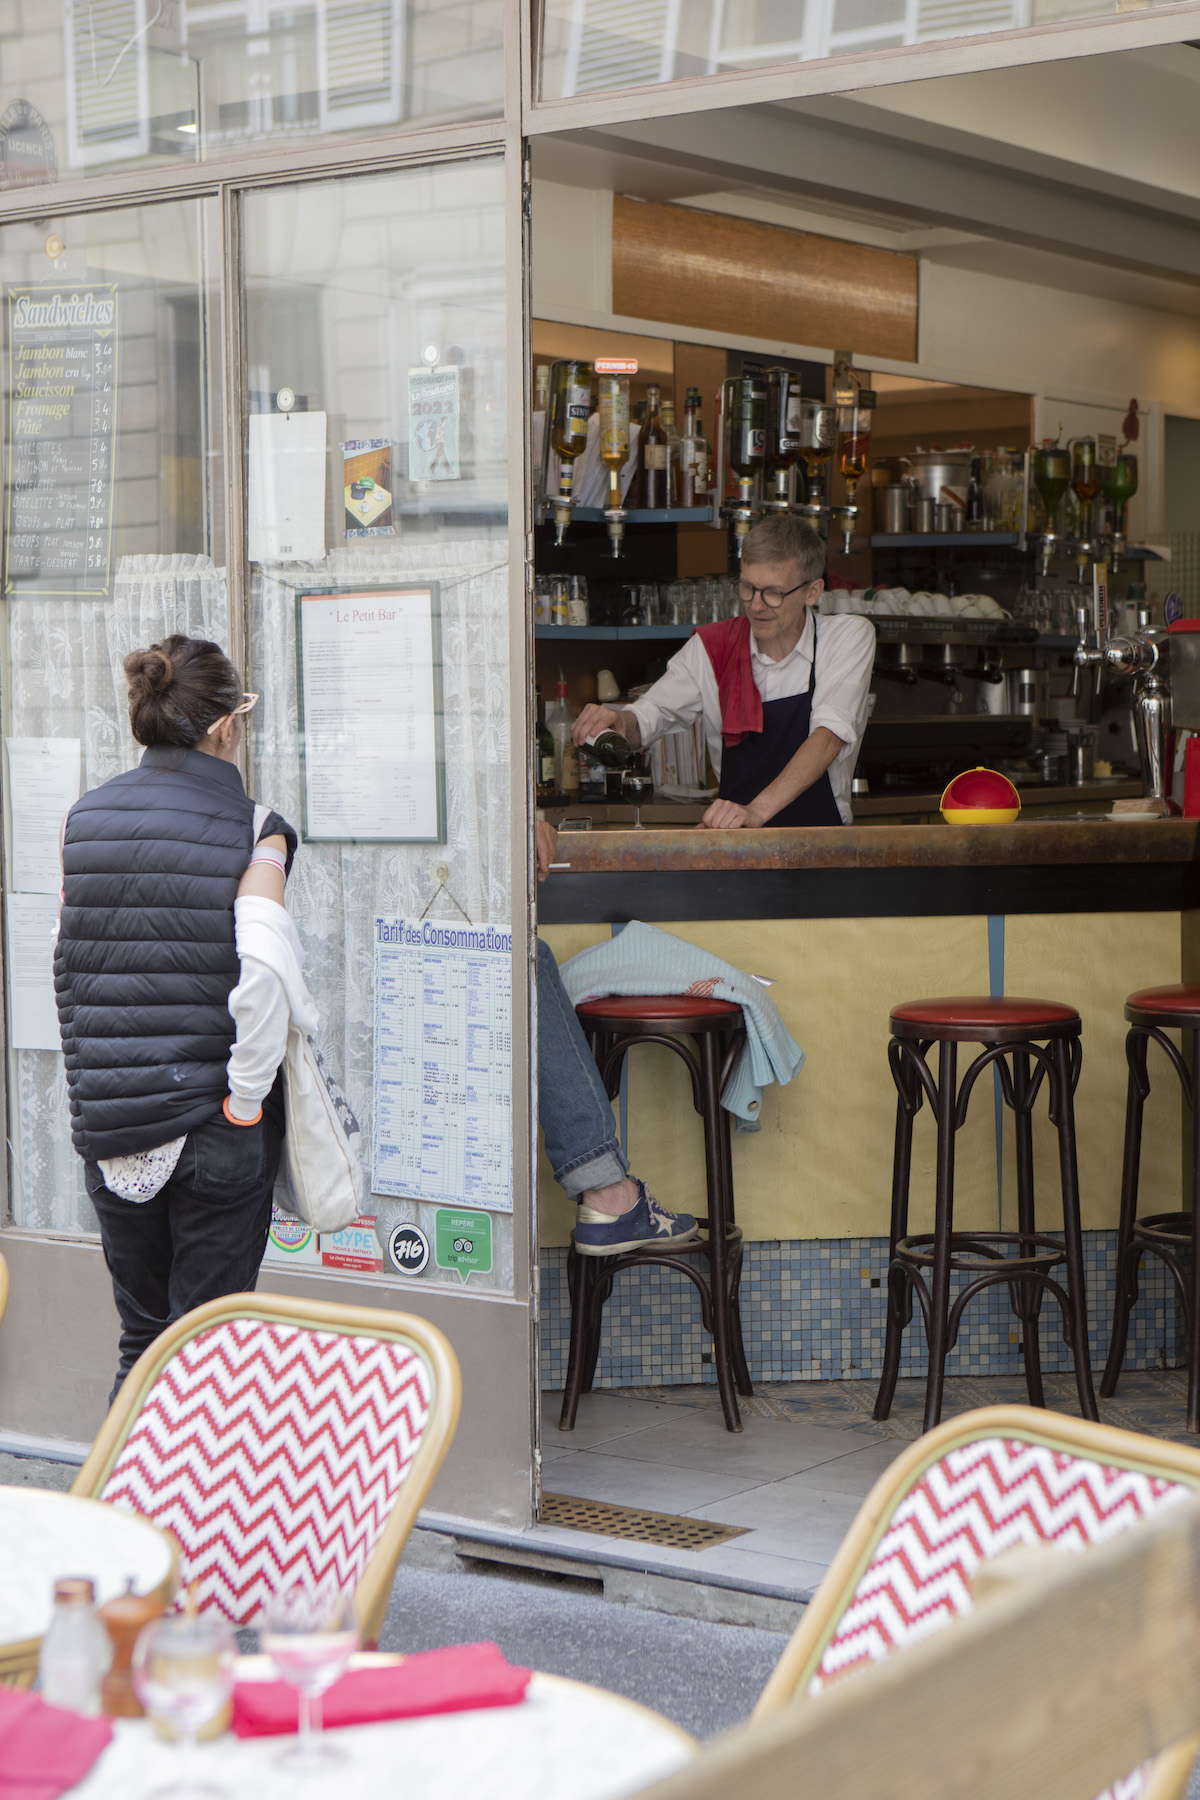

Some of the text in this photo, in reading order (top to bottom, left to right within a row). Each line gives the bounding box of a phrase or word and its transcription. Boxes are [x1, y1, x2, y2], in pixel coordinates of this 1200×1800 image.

[30, 107, 53, 151] PARIS
[8, 138, 43, 156] LICENCE
[14, 292, 113, 328] Sandwiches
[15, 344, 64, 361] Jambon
[65, 348, 88, 359] blanc
[15, 363, 64, 380] Jambon
[65, 369, 79, 378] cru
[15, 381, 75, 398] Saucisson
[411, 383, 454, 401] Le Routard
[16, 400, 71, 420] Fromage
[412, 400, 454, 416] 2022
[15, 418, 42, 435] Pâté
[15, 479, 56, 491] OMELETTE
[12, 496, 53, 509] OMELETTE
[55, 517, 76, 529] PLAT
[13, 534, 40, 548] OEUFS
[336, 608, 397, 623] Le Petit Bar
[376, 918, 512, 951] Tarif des Consommations
[451, 1218, 475, 1228] REPÉRÉ
[332, 1231, 373, 1249] QYPE
[395, 1239, 423, 1259] 716
[353, 1257, 375, 1265] internautes
[448, 1254, 479, 1265] tripadvisor
